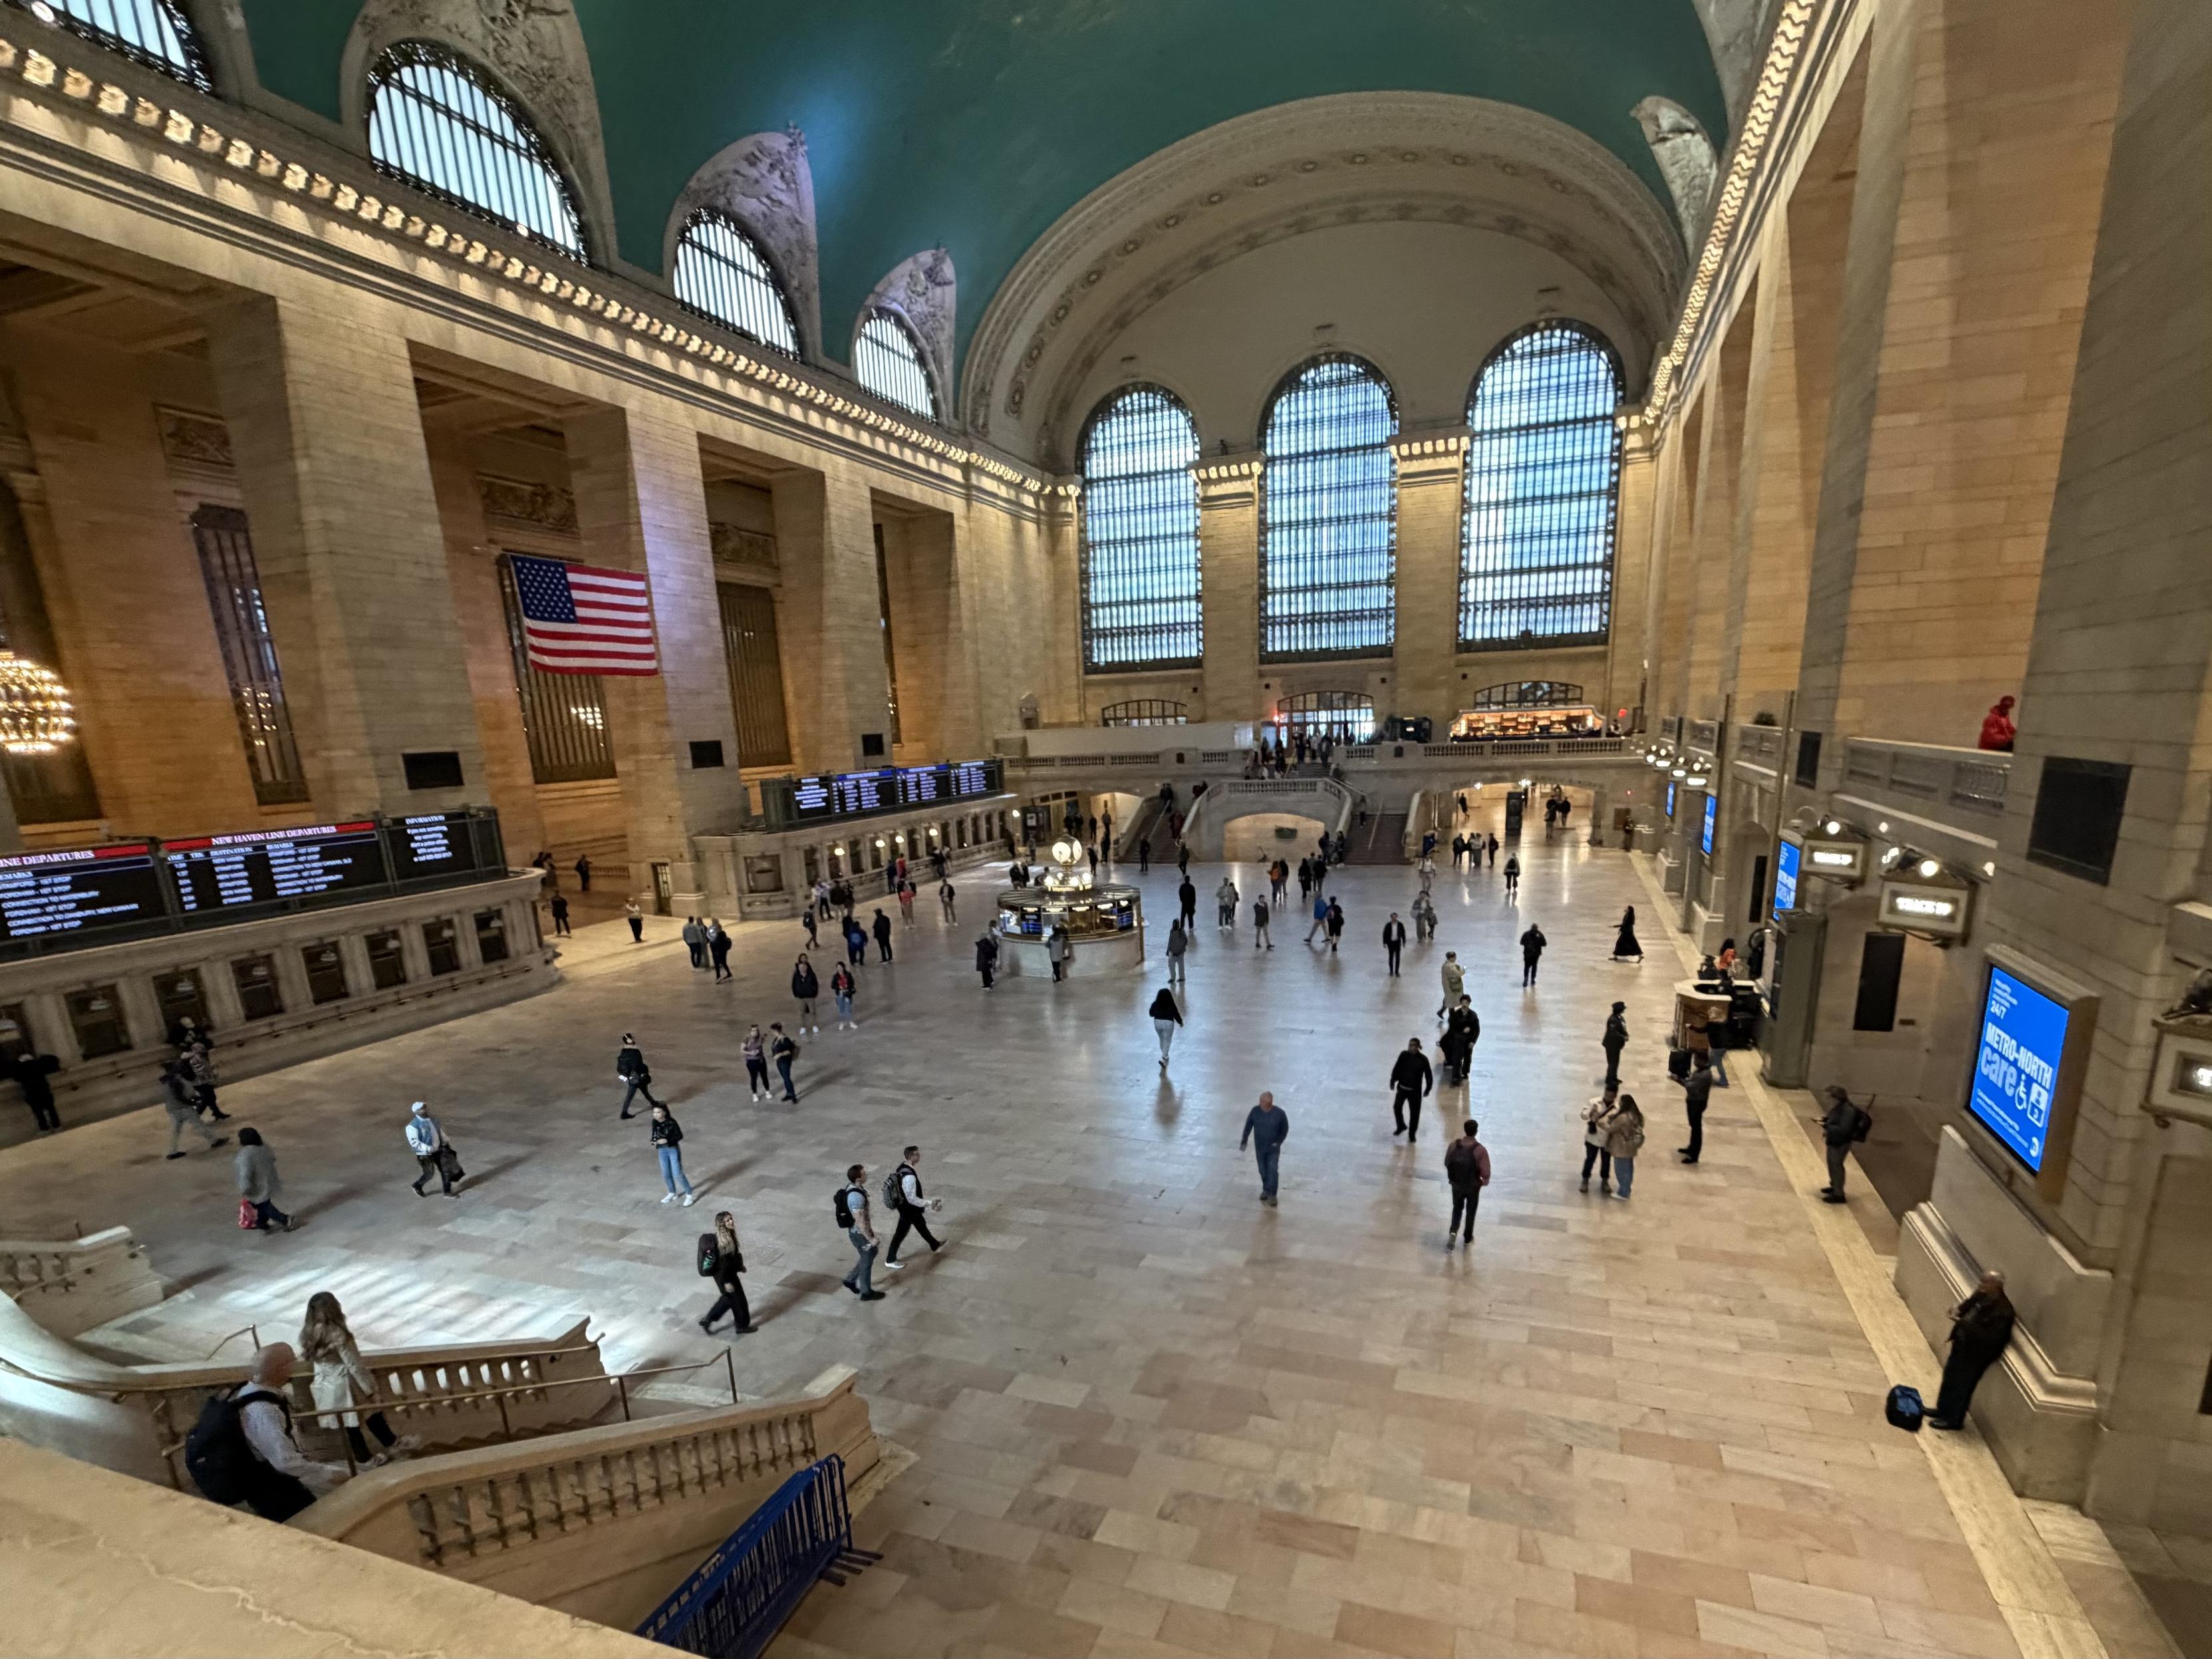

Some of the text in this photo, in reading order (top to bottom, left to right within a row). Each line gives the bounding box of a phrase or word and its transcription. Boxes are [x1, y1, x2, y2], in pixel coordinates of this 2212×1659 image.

[211, 836, 233, 845] NEW
[234, 833, 265, 843] HAVEN
[287, 826, 337, 837] DEPARTURES
[22, 850, 96, 865] DEPARTURES
[1991, 1000, 2006, 1020] 24/7
[1985, 1022, 2053, 1090] METRO-NORTH
[1981, 1046, 2018, 1097] care
